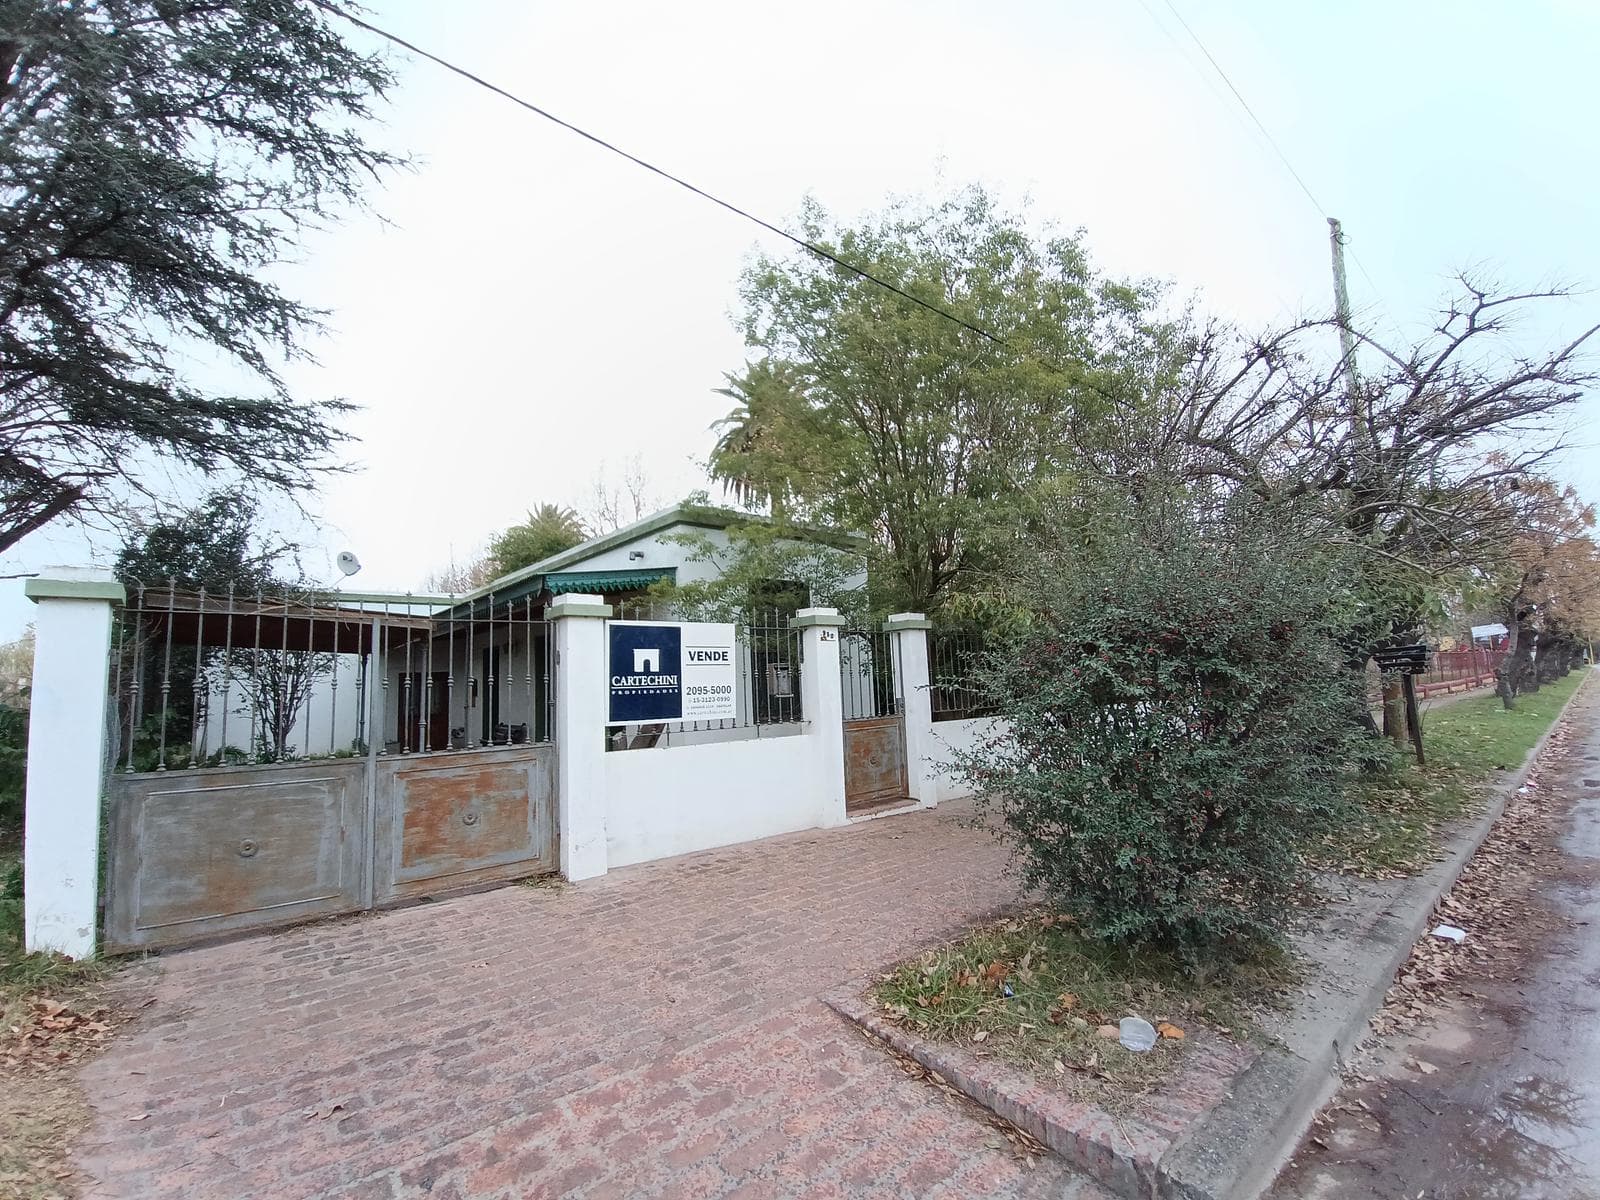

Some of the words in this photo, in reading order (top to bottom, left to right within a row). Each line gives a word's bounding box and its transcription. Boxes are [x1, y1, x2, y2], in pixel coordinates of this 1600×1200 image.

[688, 651, 729, 661] VENDE
[611, 675, 678, 686] CARTECHINI
[686, 685, 732, 695] 2095-5000
